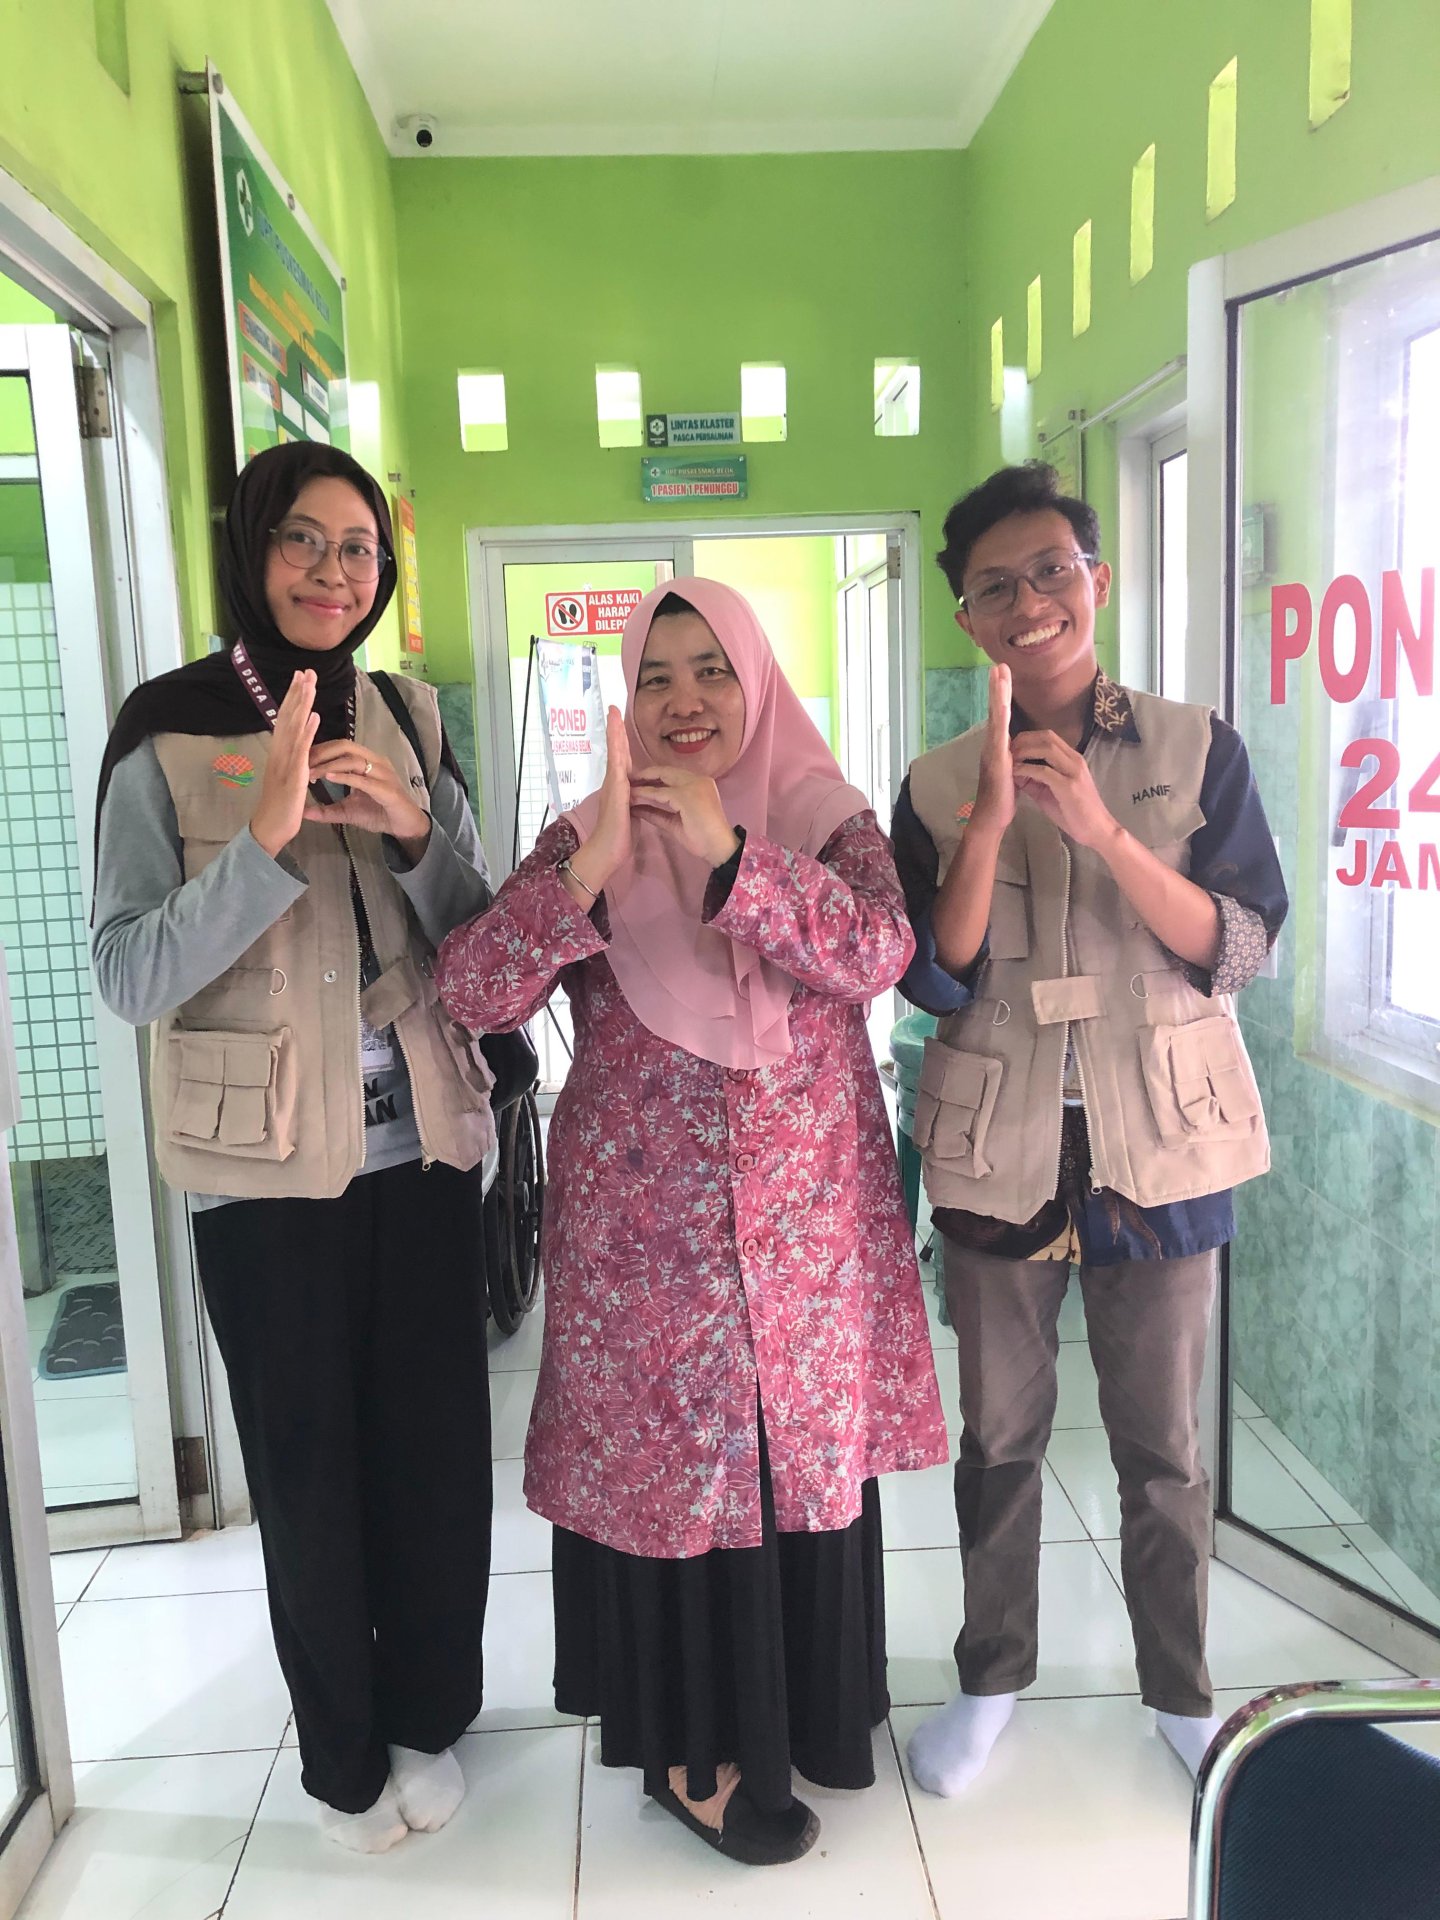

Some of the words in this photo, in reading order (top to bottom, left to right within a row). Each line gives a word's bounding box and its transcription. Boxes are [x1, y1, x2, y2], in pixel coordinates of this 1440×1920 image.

[671, 420, 699, 430] LINTAS
[700, 419, 734, 429] KLASTER
[673, 433, 694, 442] PASCA
[695, 432, 733, 441] PERSALINAN
[652, 485, 657, 496] 1
[657, 484, 687, 496] PASIEN
[694, 482, 738, 495] PENUNGGU
[589, 595, 613, 605] ALAS
[616, 593, 639, 604] KAKI
[598, 606, 631, 618] HARAP
[596, 620, 626, 631] DILEP
[242, 668, 268, 704] DESA
[551, 708, 587, 731] PONED
[1132, 785, 1171, 804] HANIF
